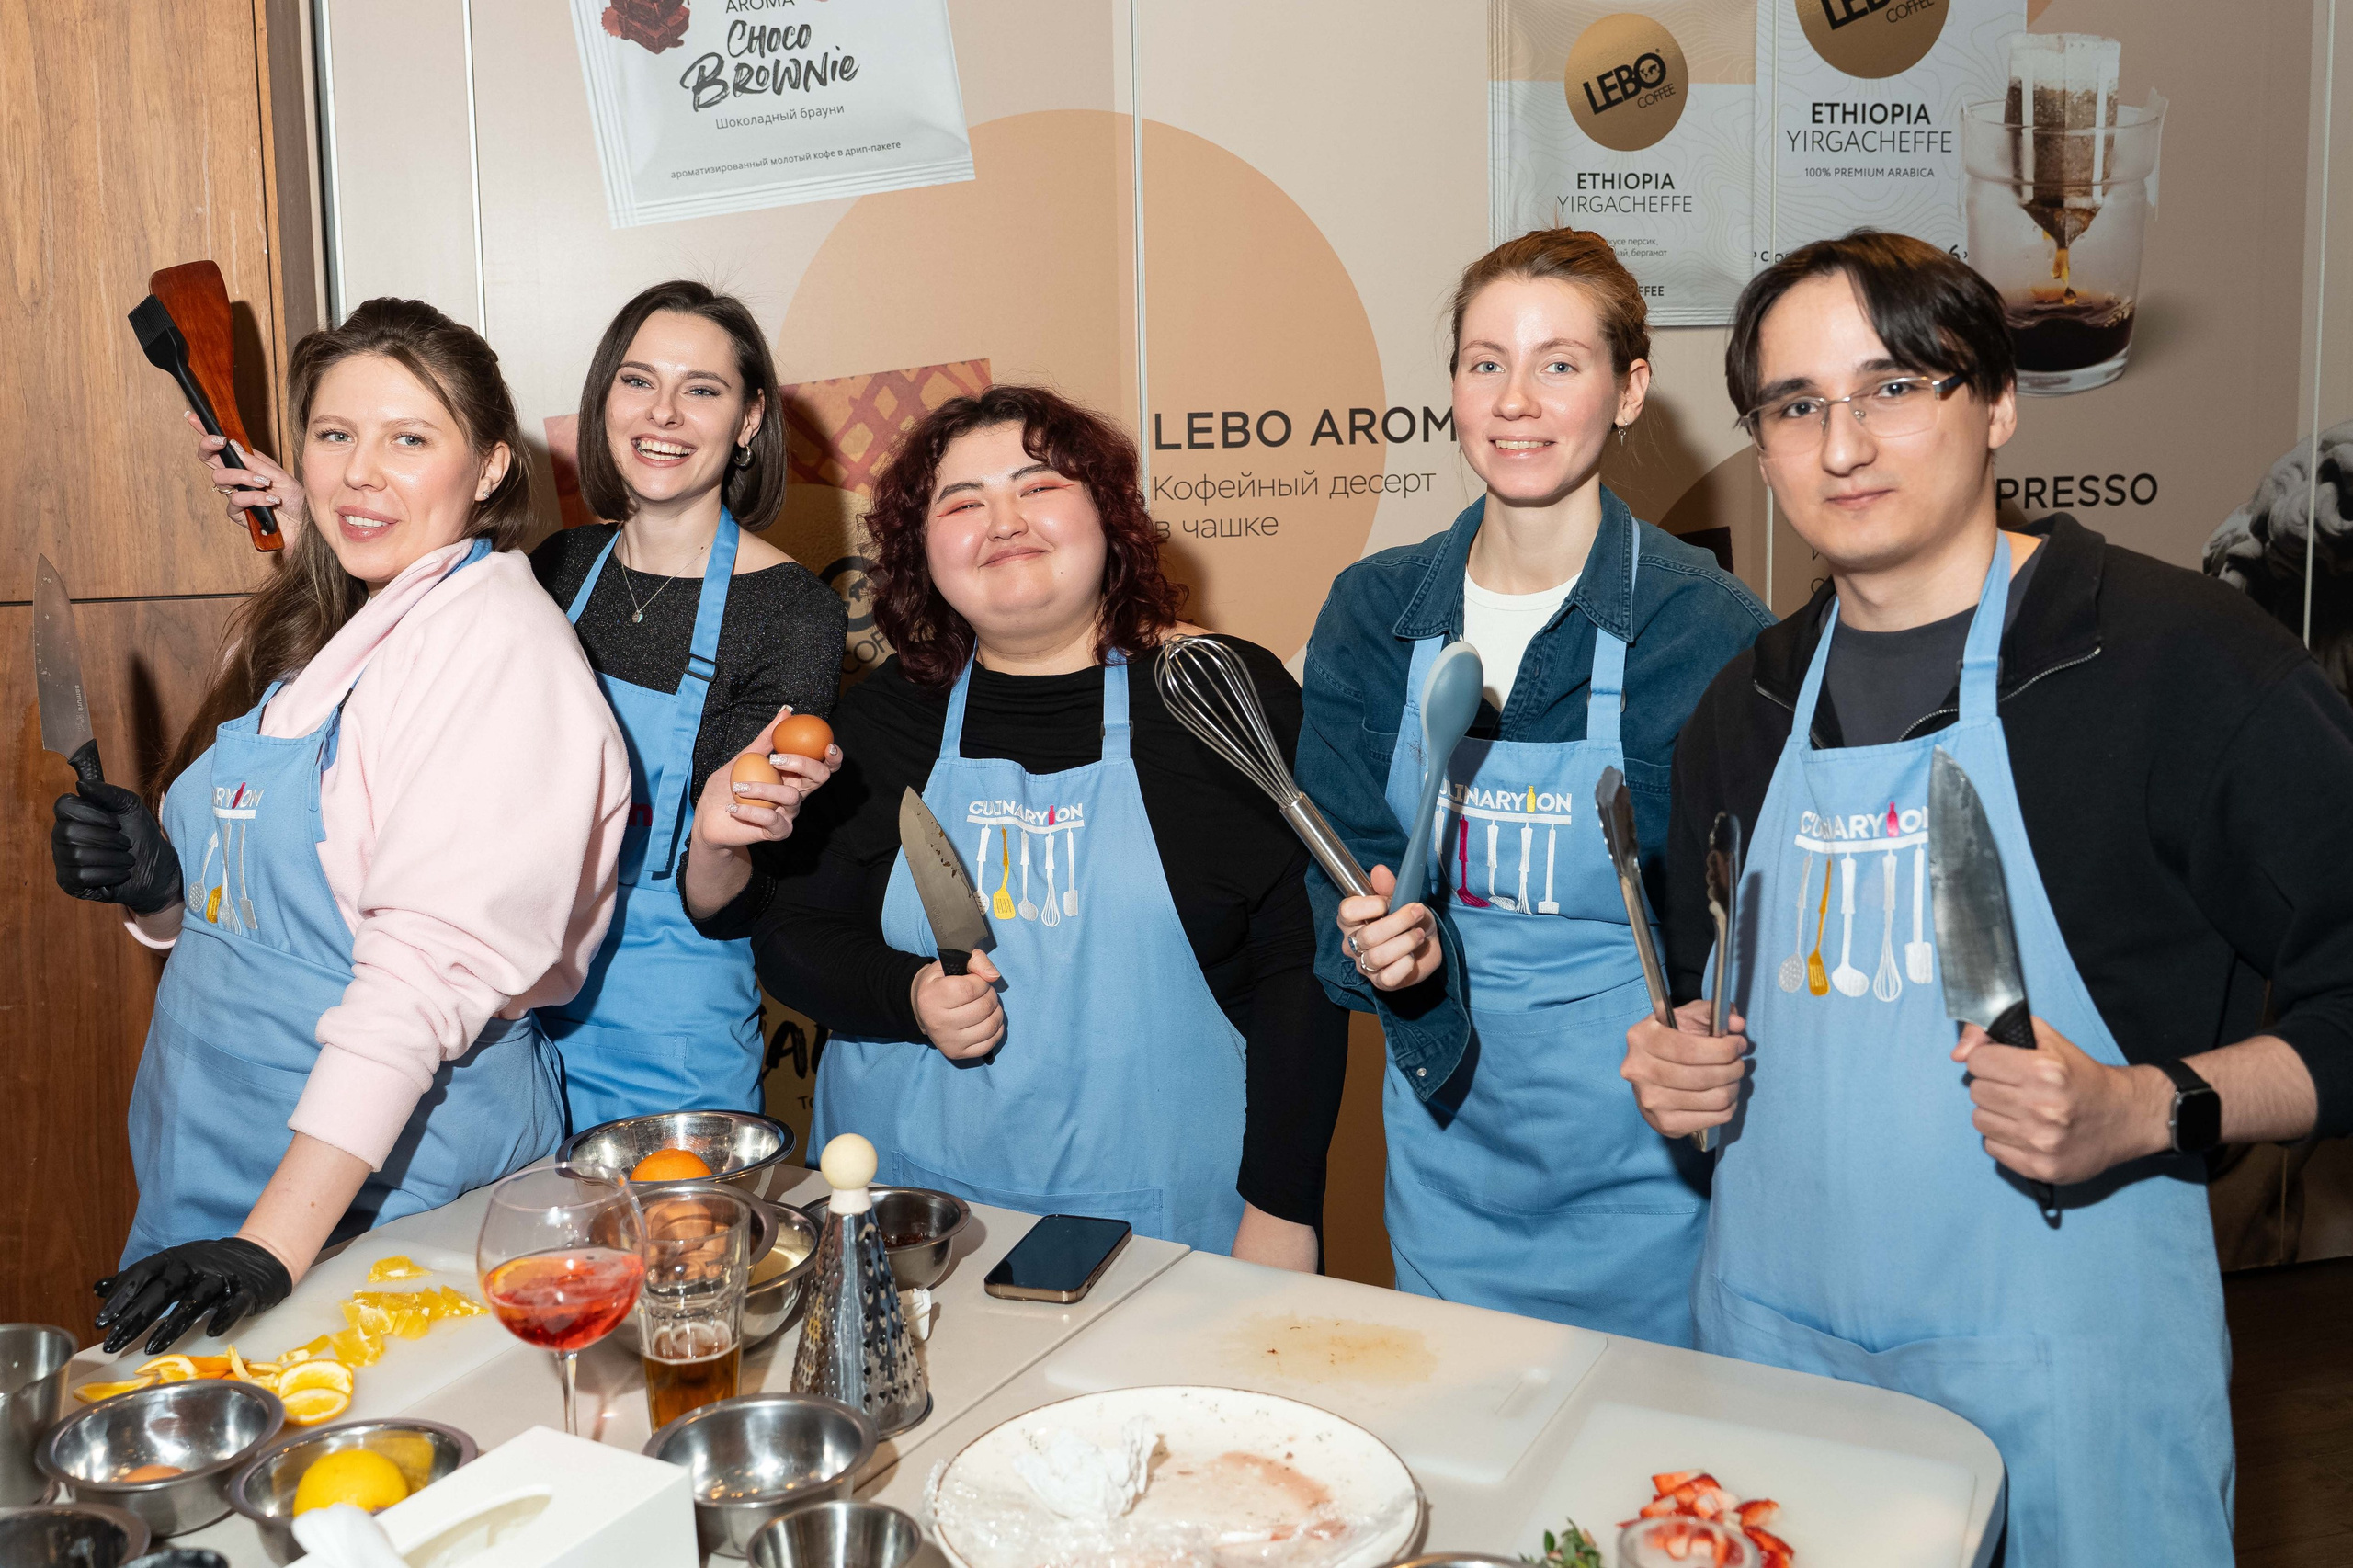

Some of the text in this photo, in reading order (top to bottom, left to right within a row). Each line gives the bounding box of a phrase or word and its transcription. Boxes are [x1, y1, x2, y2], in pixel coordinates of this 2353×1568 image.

[1583, 52, 1666, 115] LEBO
[1637, 83, 1676, 108] COFFEE
[715, 105, 845, 130] Шоколадный брауни
[1812, 102, 1931, 125] ETHIOPIA
[1787, 130, 1952, 153] YIRGACHEFFE
[671, 158, 768, 180] ароматизированный
[770, 152, 812, 165] молотый
[813, 148, 835, 160] кофе
[845, 141, 902, 157] дрип-пакете
[1577, 173, 1675, 190] ETHIOPIA
[1805, 167, 1935, 178] 100% PREMIUM ARABICA
[1557, 196, 1692, 213] YIRGACHEFFE
[1628, 239, 1659, 247] персик,
[1631, 248, 1667, 258] бергамот
[1154, 410, 1292, 450] LEBO
[1154, 470, 1437, 506] Кофейный десерт
[1995, 472, 2158, 510] PRESSO
[1182, 516, 1279, 539] чашке
